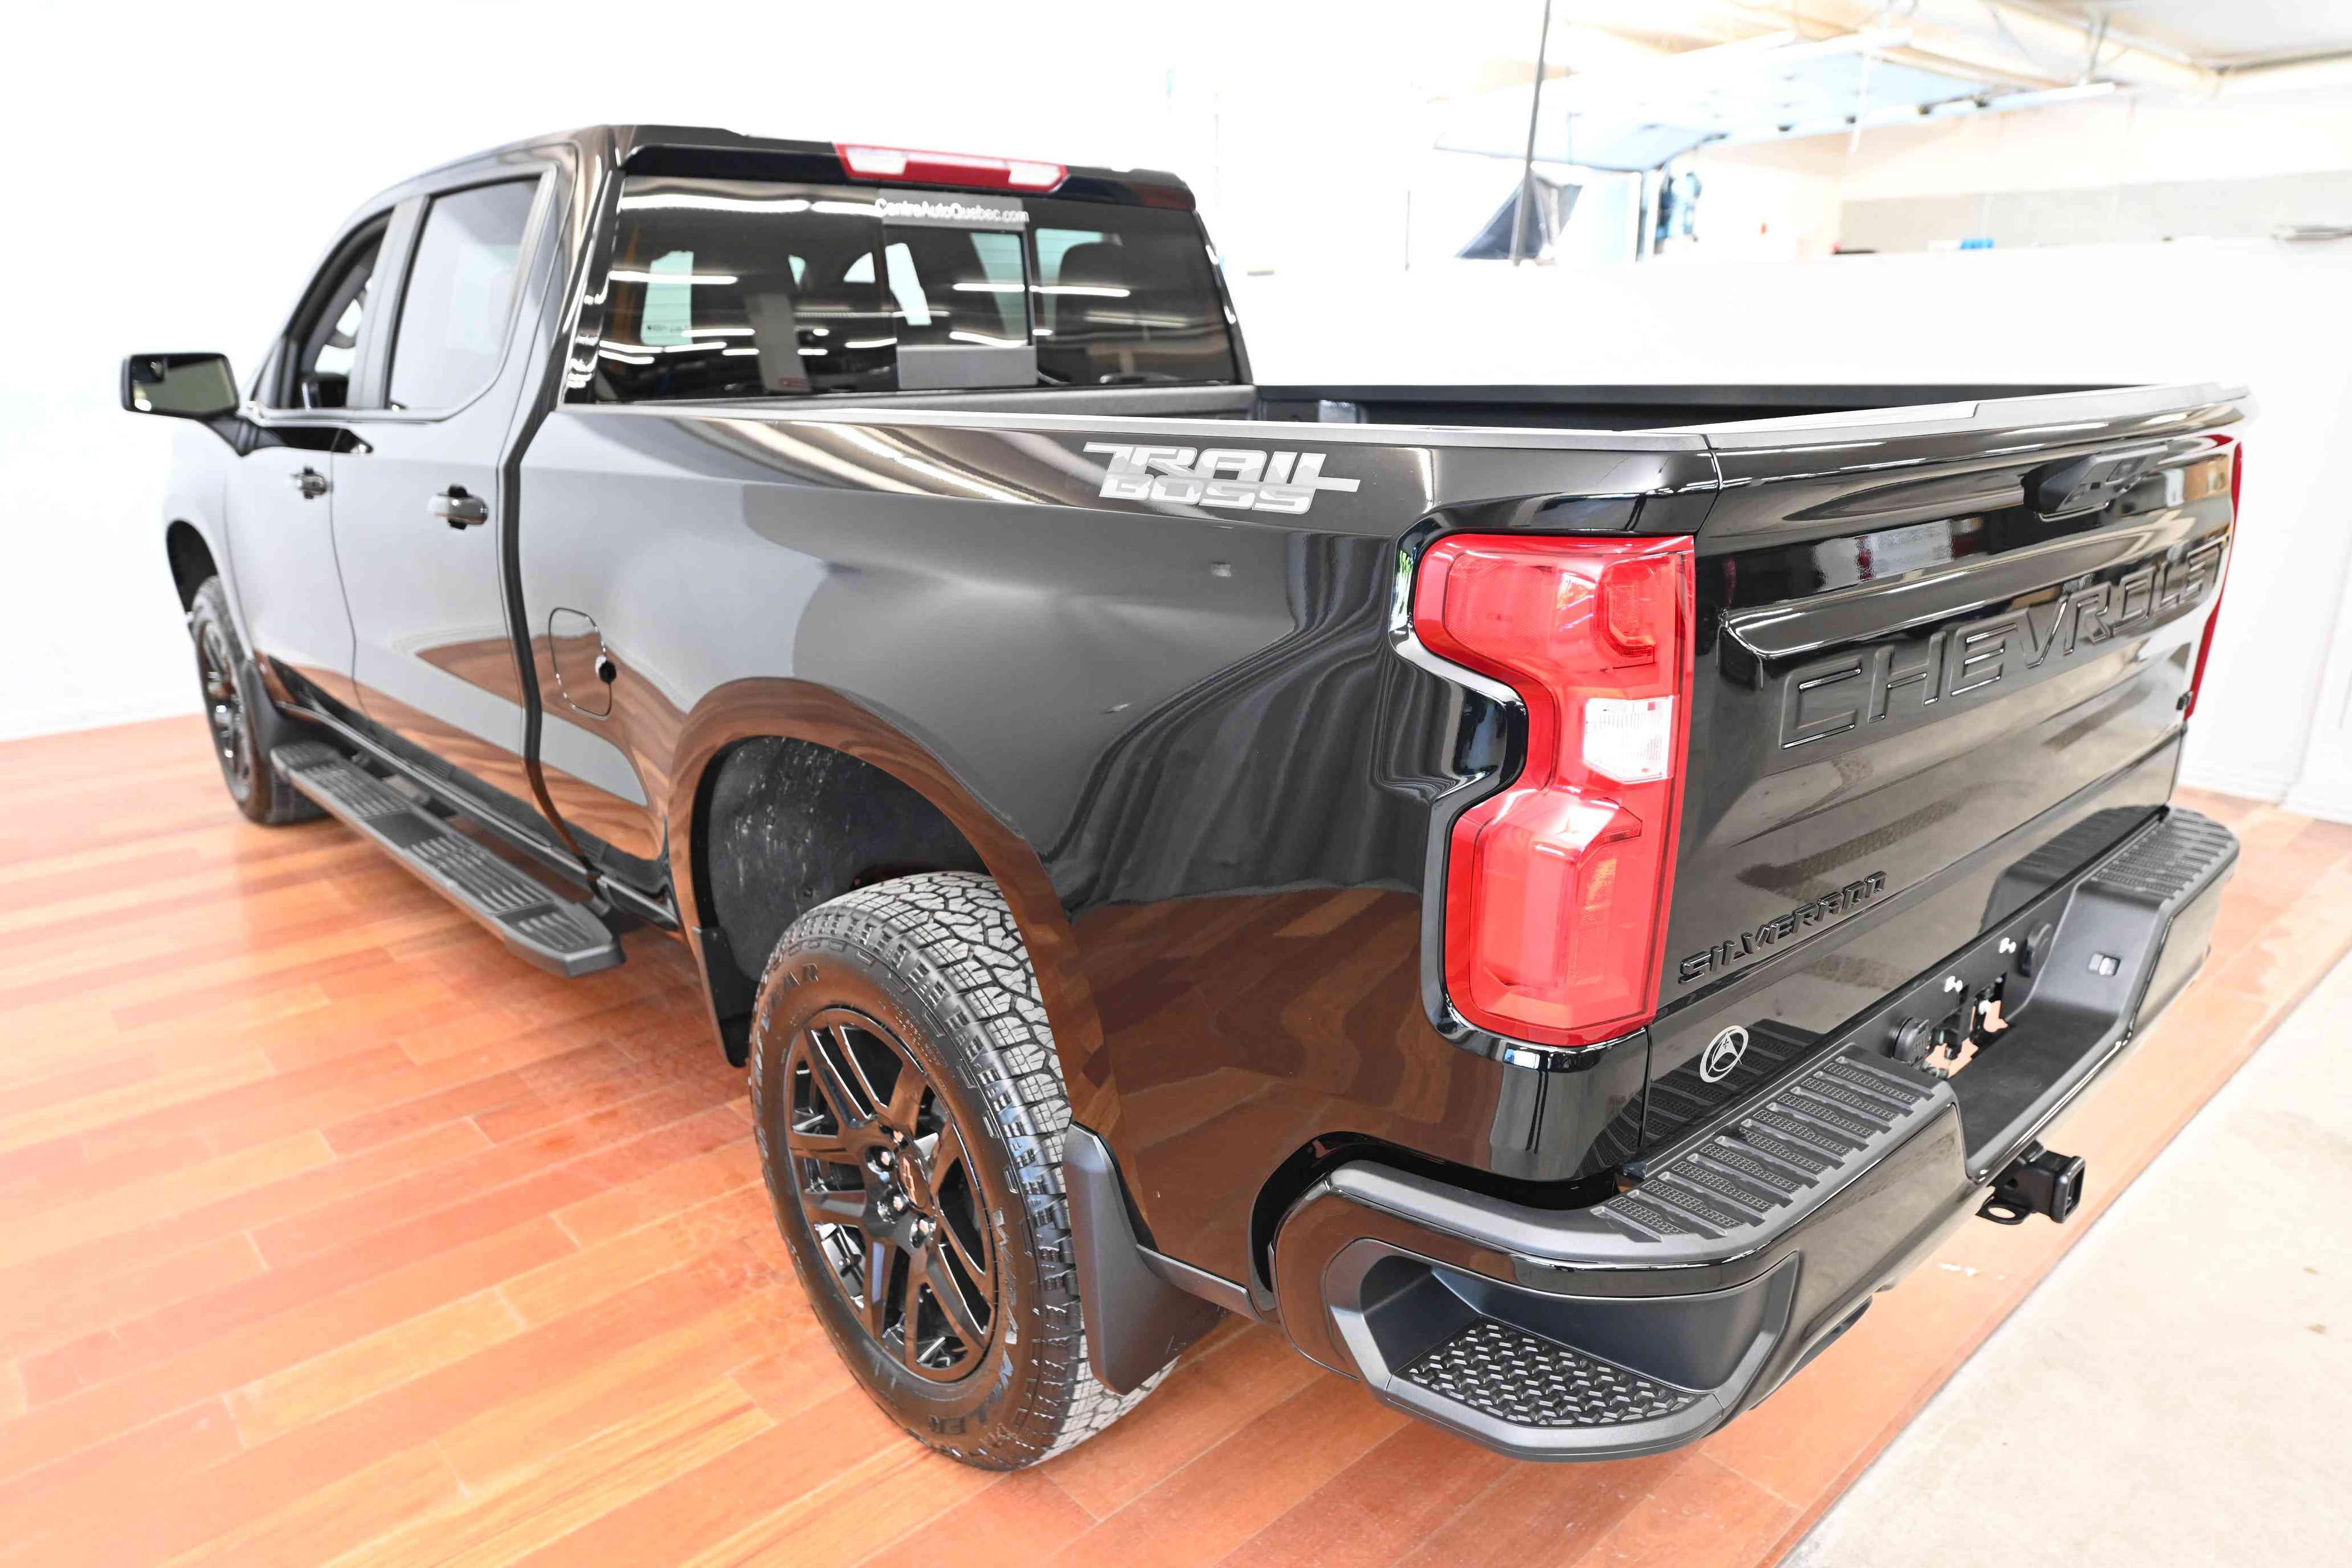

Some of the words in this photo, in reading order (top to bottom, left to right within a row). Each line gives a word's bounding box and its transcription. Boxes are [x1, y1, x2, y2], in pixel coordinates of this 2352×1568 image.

[1083, 442, 1361, 492] TRAIL
[1099, 472, 1317, 514] BOSS
[1678, 870, 1888, 984] SILVERADO
